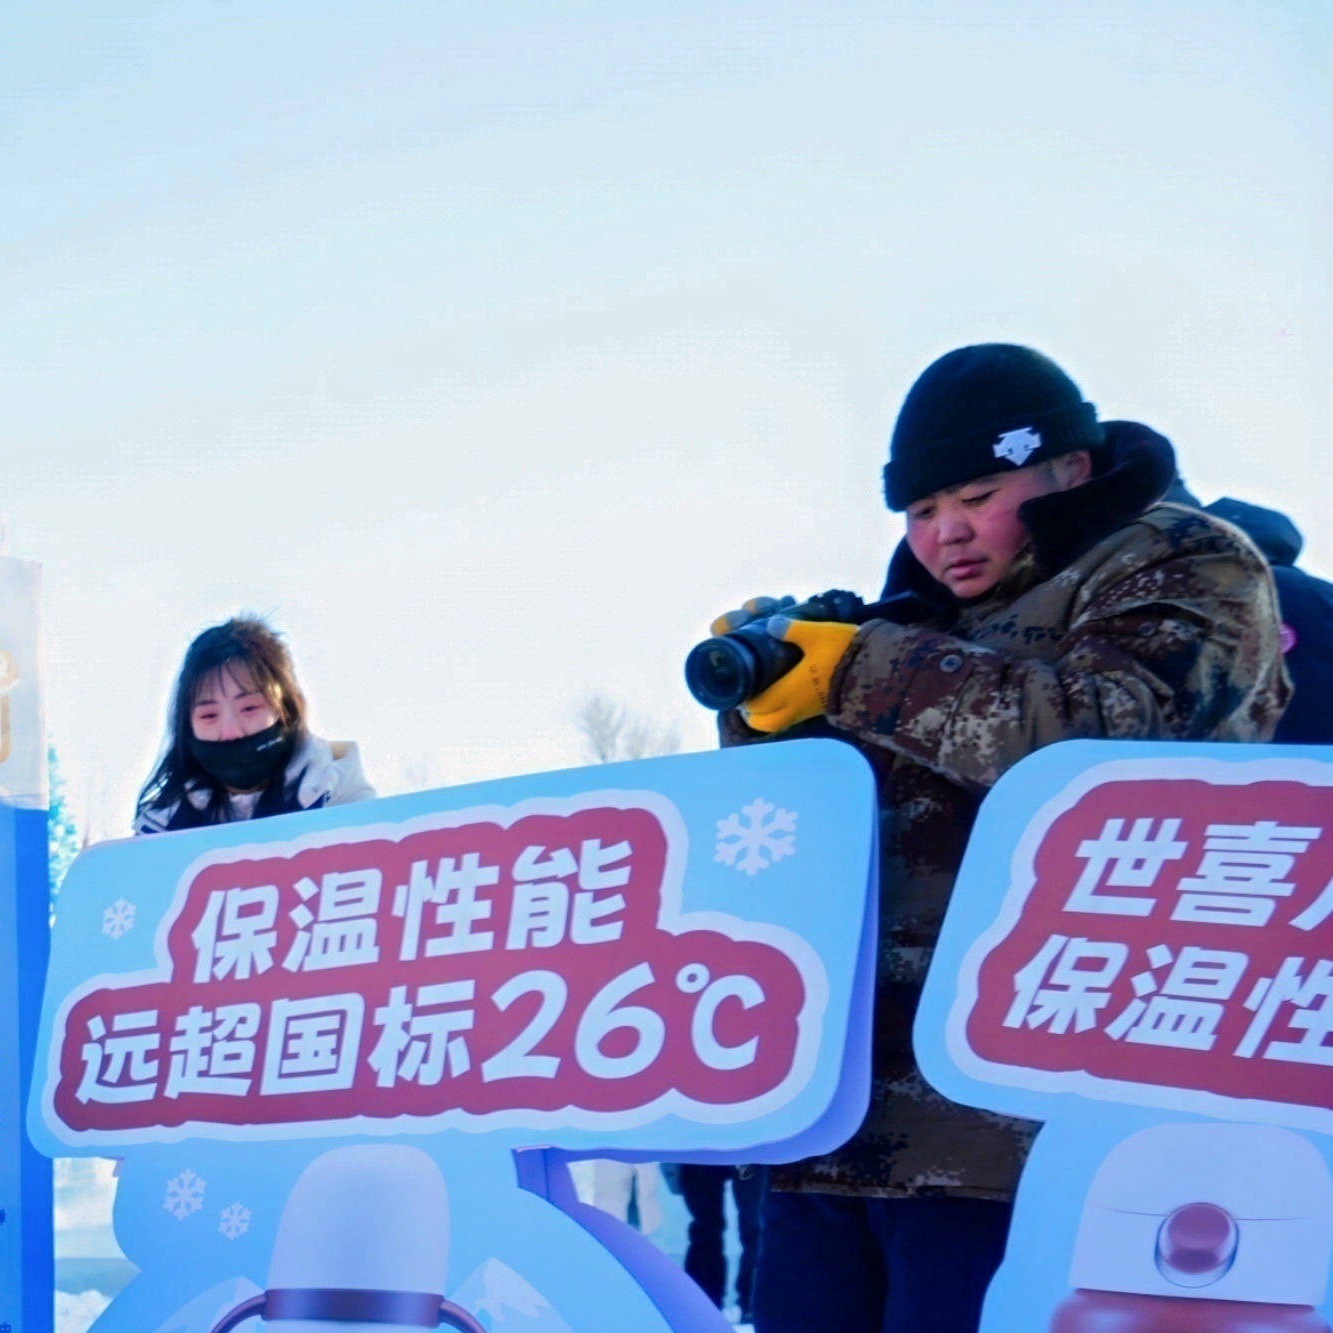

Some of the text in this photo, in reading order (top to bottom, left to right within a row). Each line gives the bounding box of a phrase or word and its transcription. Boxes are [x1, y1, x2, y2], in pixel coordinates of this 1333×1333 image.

[191, 838, 634, 984] 保温性能
[1062, 817, 1333, 932] 世喜
